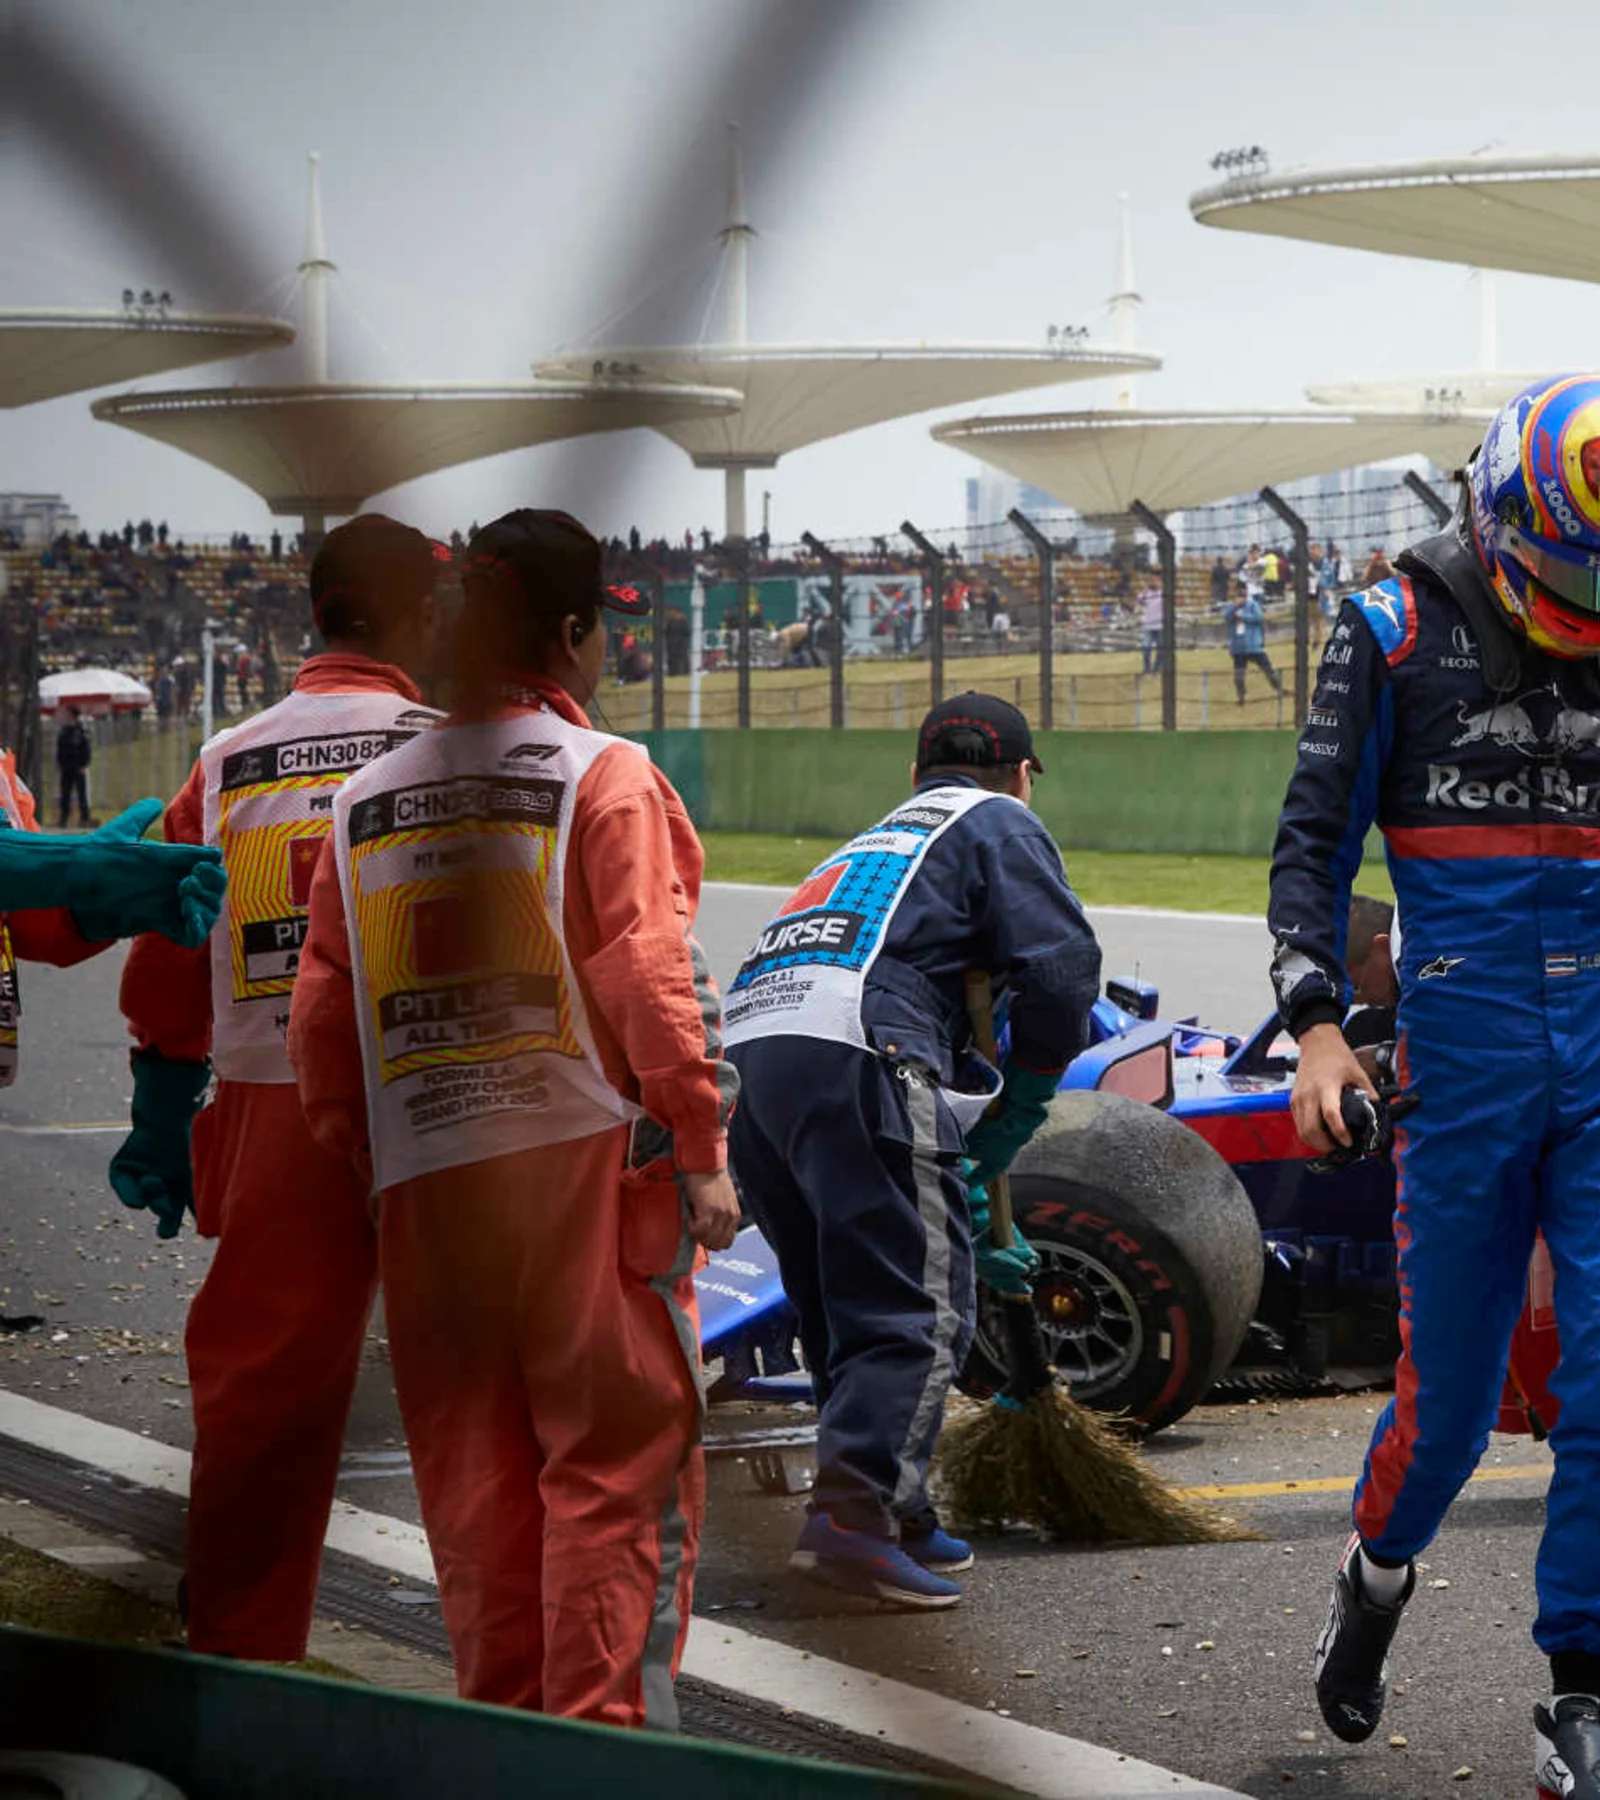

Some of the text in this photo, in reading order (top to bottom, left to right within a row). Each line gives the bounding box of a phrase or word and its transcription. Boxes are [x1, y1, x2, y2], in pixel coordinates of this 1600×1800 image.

[1440, 657, 1479, 669] HON
[279, 740, 387, 771] CHN3082
[1425, 764, 1530, 809] Red
[395, 976, 519, 1021] PIT LAE
[777, 993, 804, 1006] 2019
[405, 1025, 453, 1047] ALL
